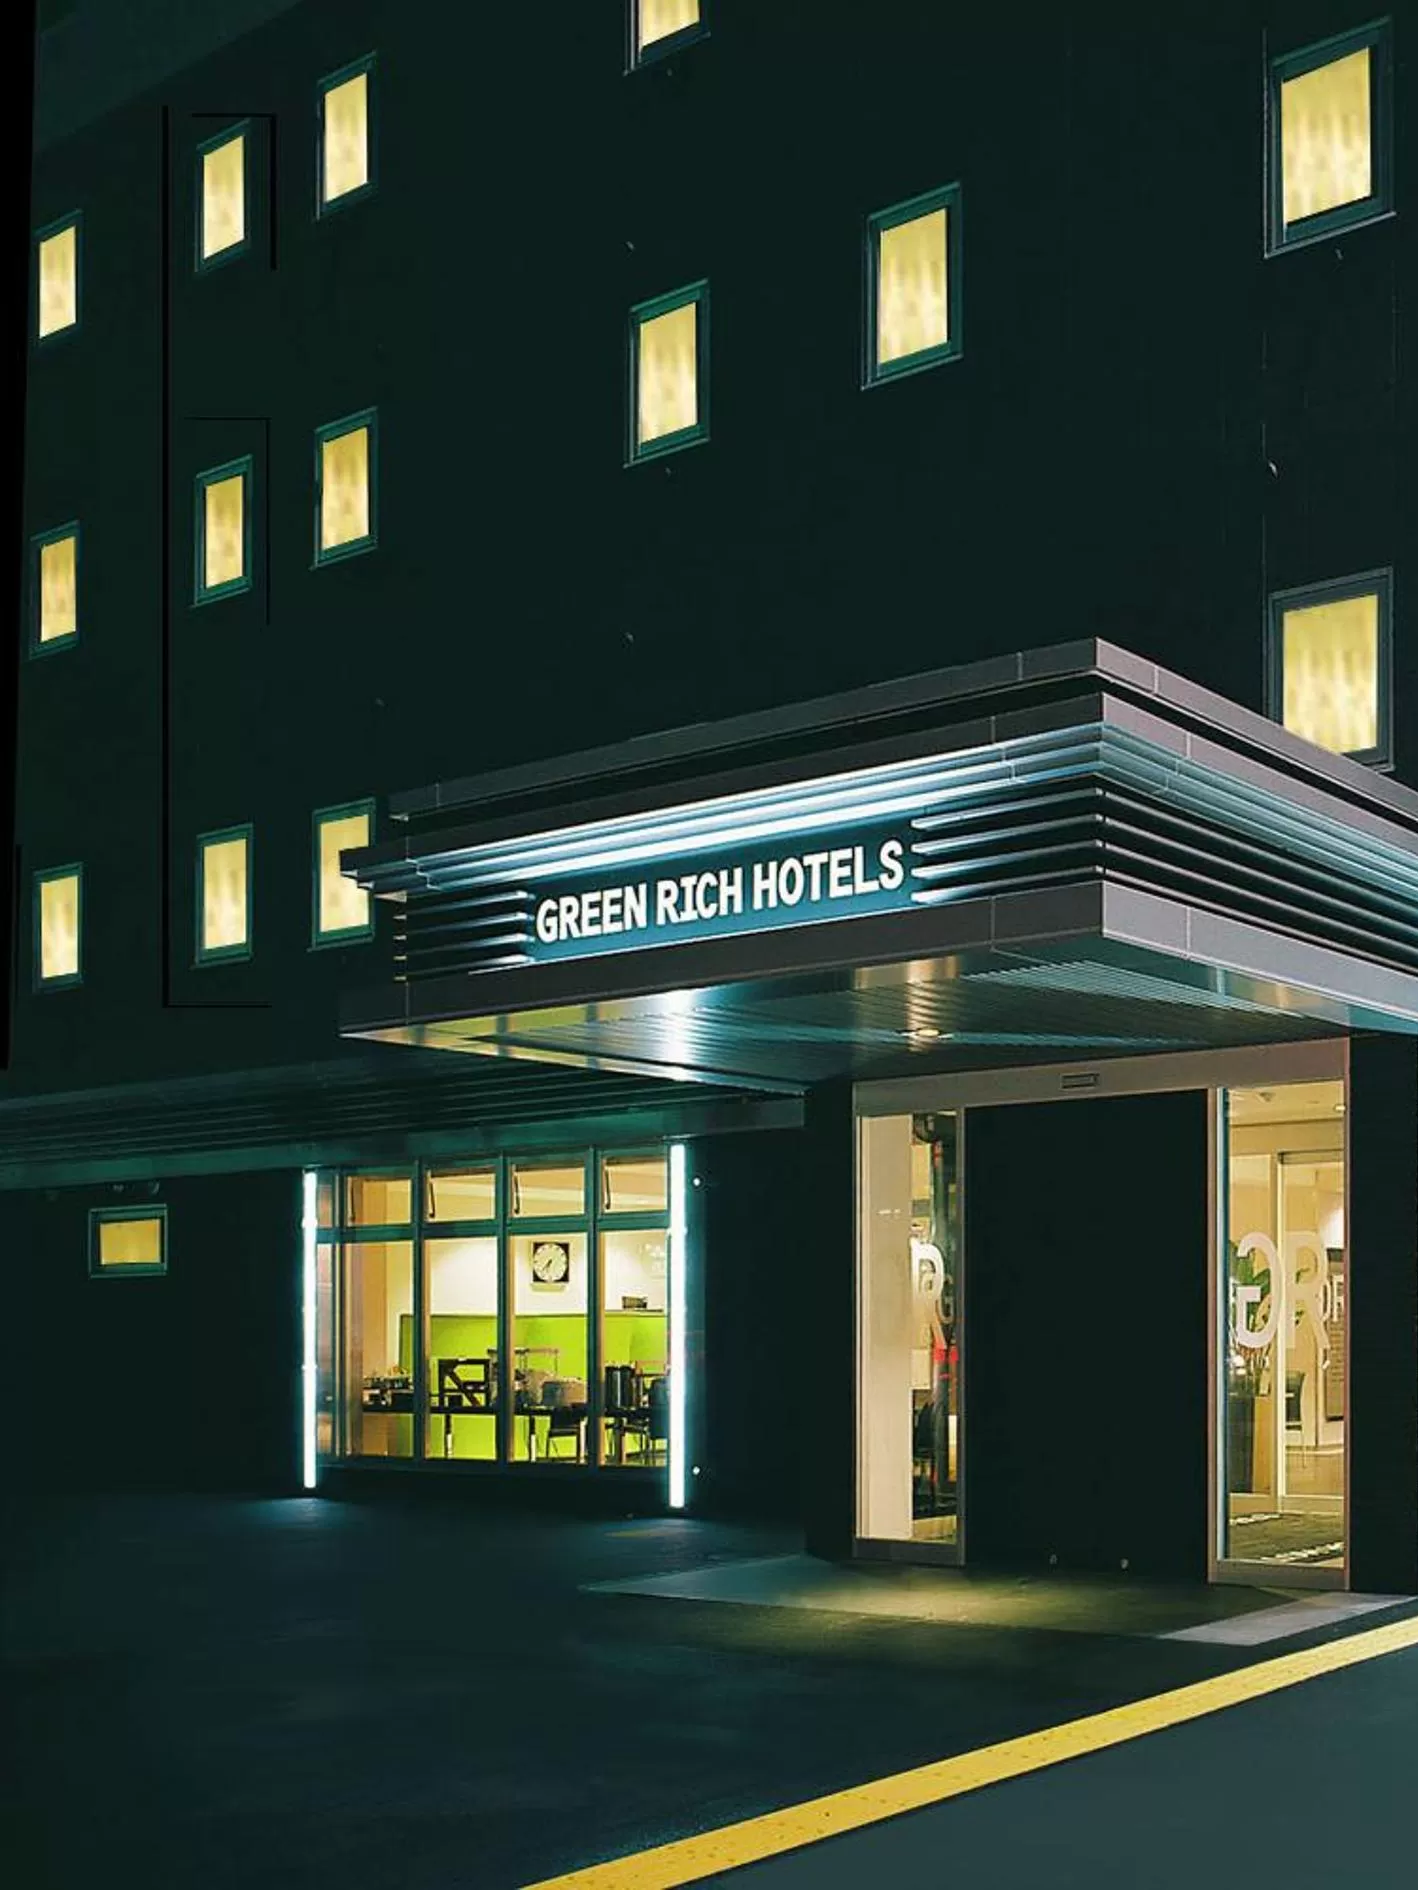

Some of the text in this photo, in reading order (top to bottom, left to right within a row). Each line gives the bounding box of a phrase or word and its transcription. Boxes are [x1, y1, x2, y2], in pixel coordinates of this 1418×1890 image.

[536, 839, 904, 943] GREEN RICH HOTELS
